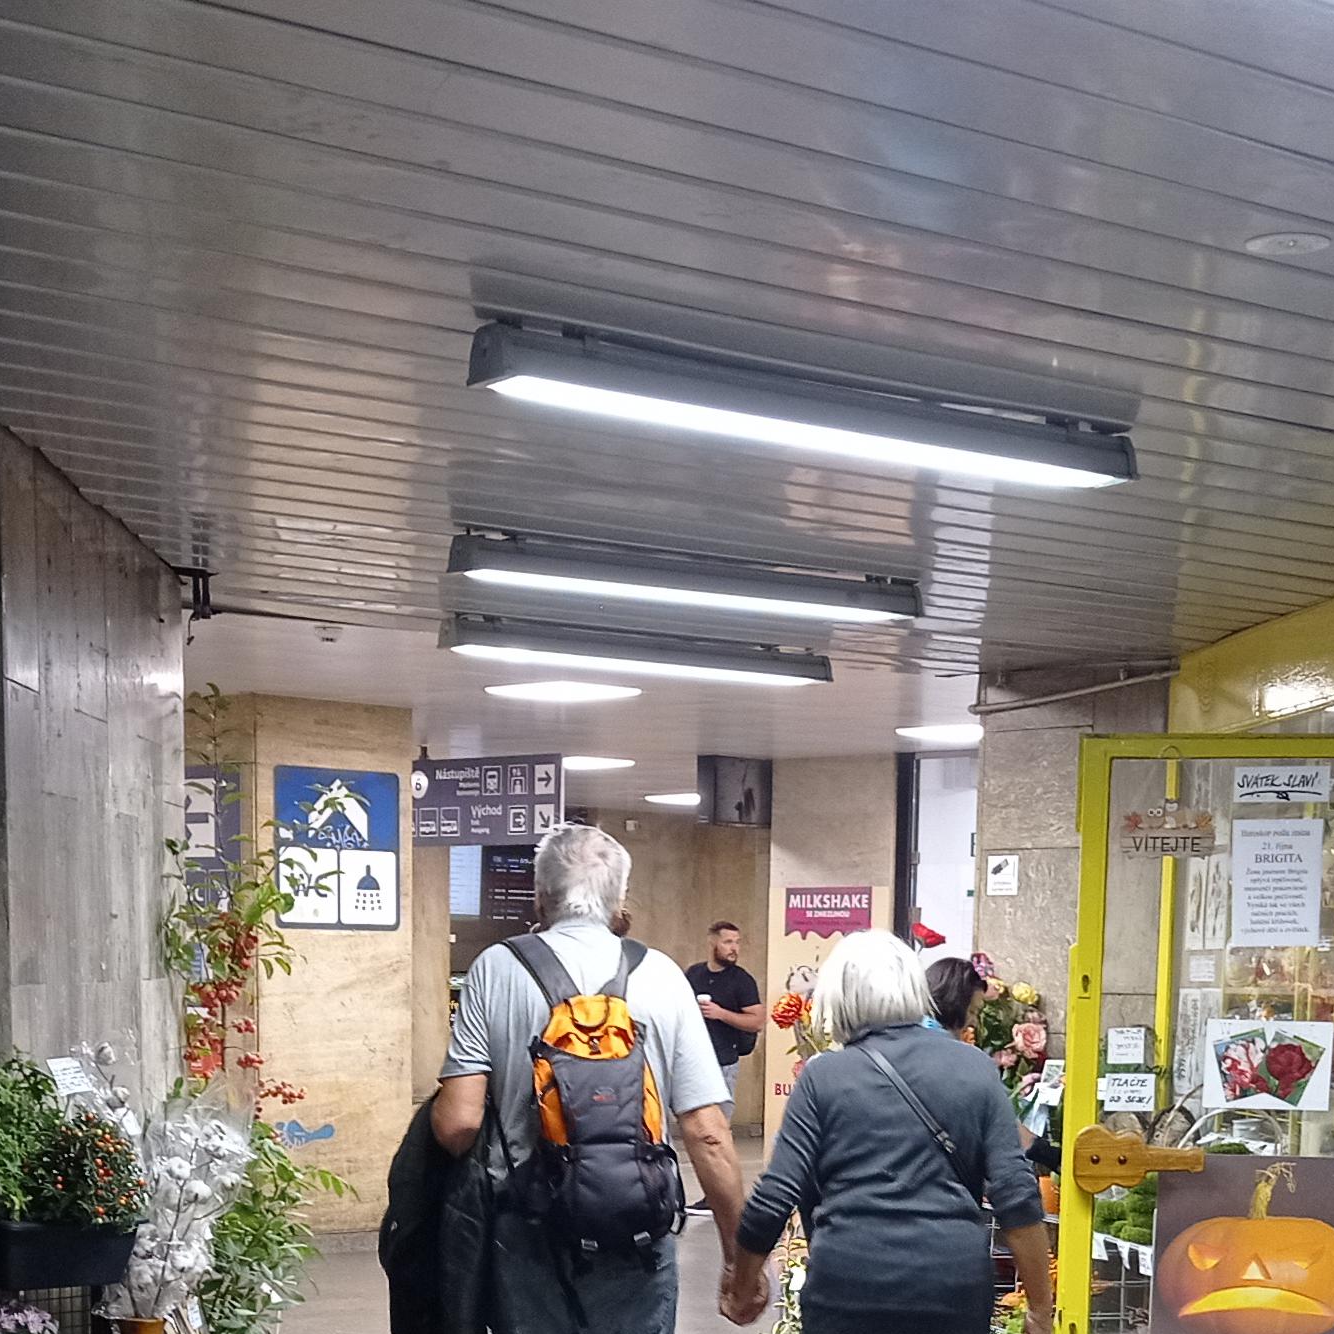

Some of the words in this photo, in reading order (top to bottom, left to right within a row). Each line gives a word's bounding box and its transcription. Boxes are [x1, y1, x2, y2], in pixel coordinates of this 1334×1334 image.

[435, 766, 480, 781] Nástupiště
[1237, 773, 1282, 789] SVÁTEK
[1283, 771, 1319, 789] SLAVÍ
[470, 804, 502, 818] Východ
[1132, 834, 1202, 852] VÍTEJTE
[1255, 853, 1303, 864] BRIGITA
[788, 893, 870, 909] MILKSHAKE
[1112, 1077, 1148, 1087] TLAČTE
[774, 1083, 793, 1096] BU
